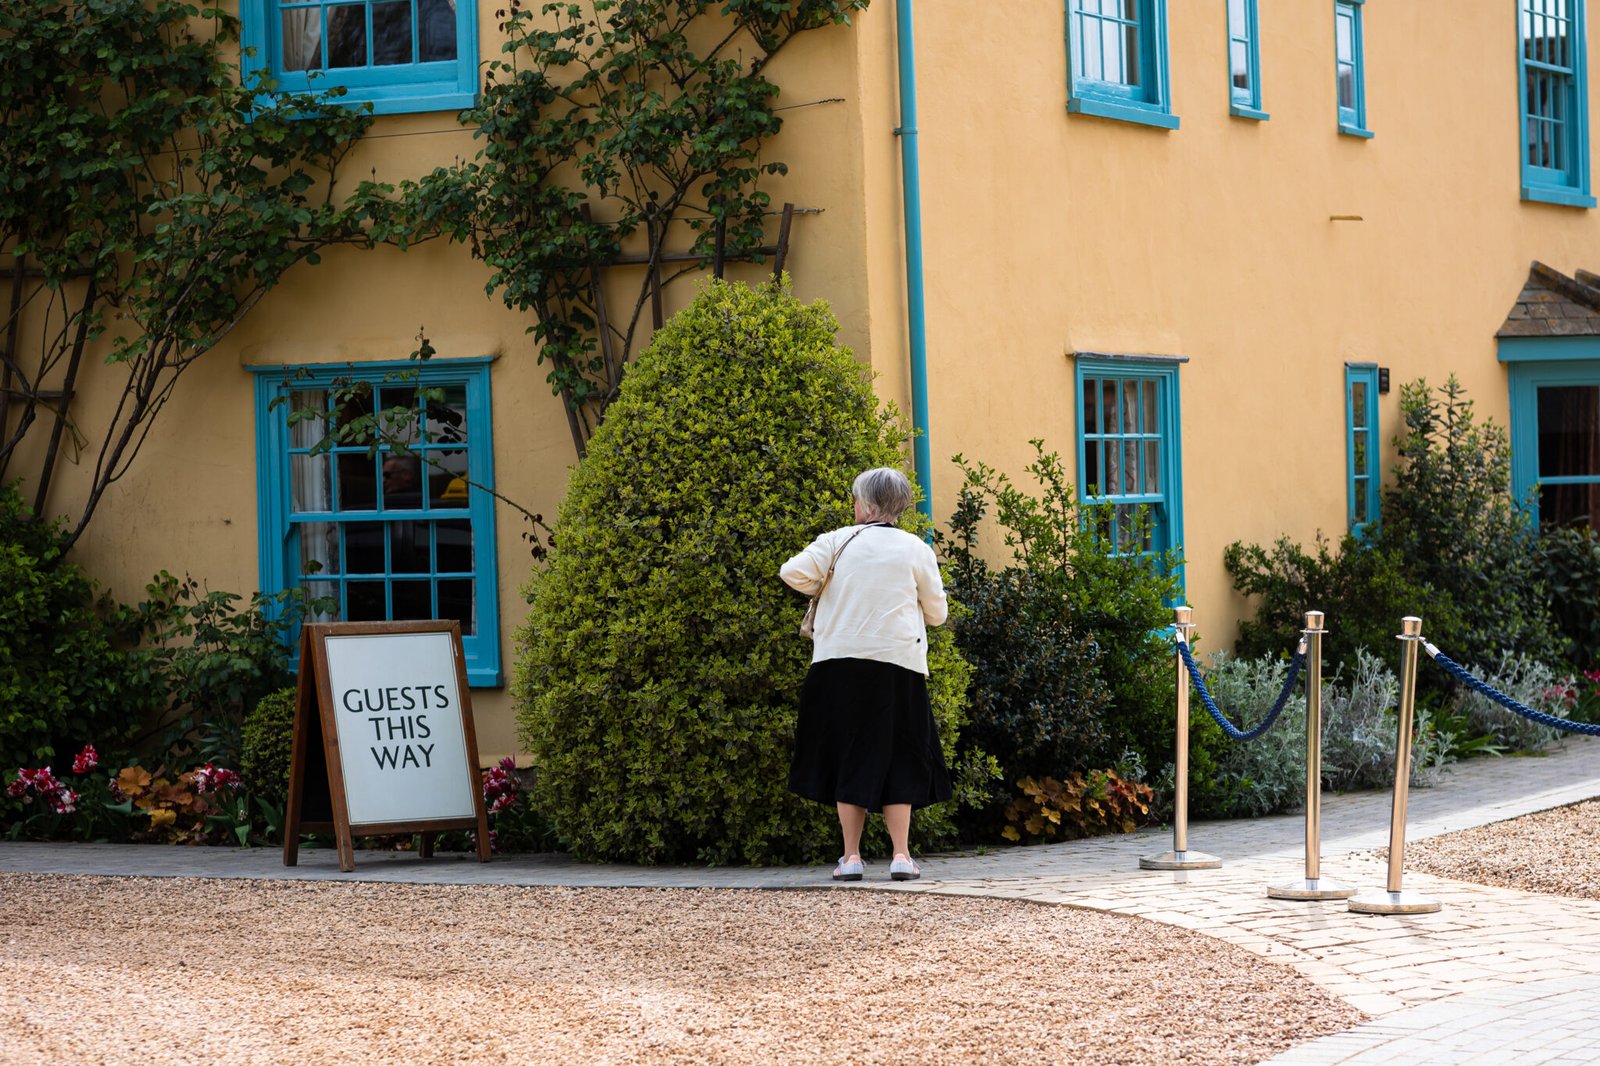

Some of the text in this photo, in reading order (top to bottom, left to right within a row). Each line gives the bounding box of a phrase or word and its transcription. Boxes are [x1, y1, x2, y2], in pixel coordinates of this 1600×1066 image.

[342, 685, 450, 713] GUESTS
[368, 715, 431, 741] THIS
[370, 743, 435, 770] WAY
